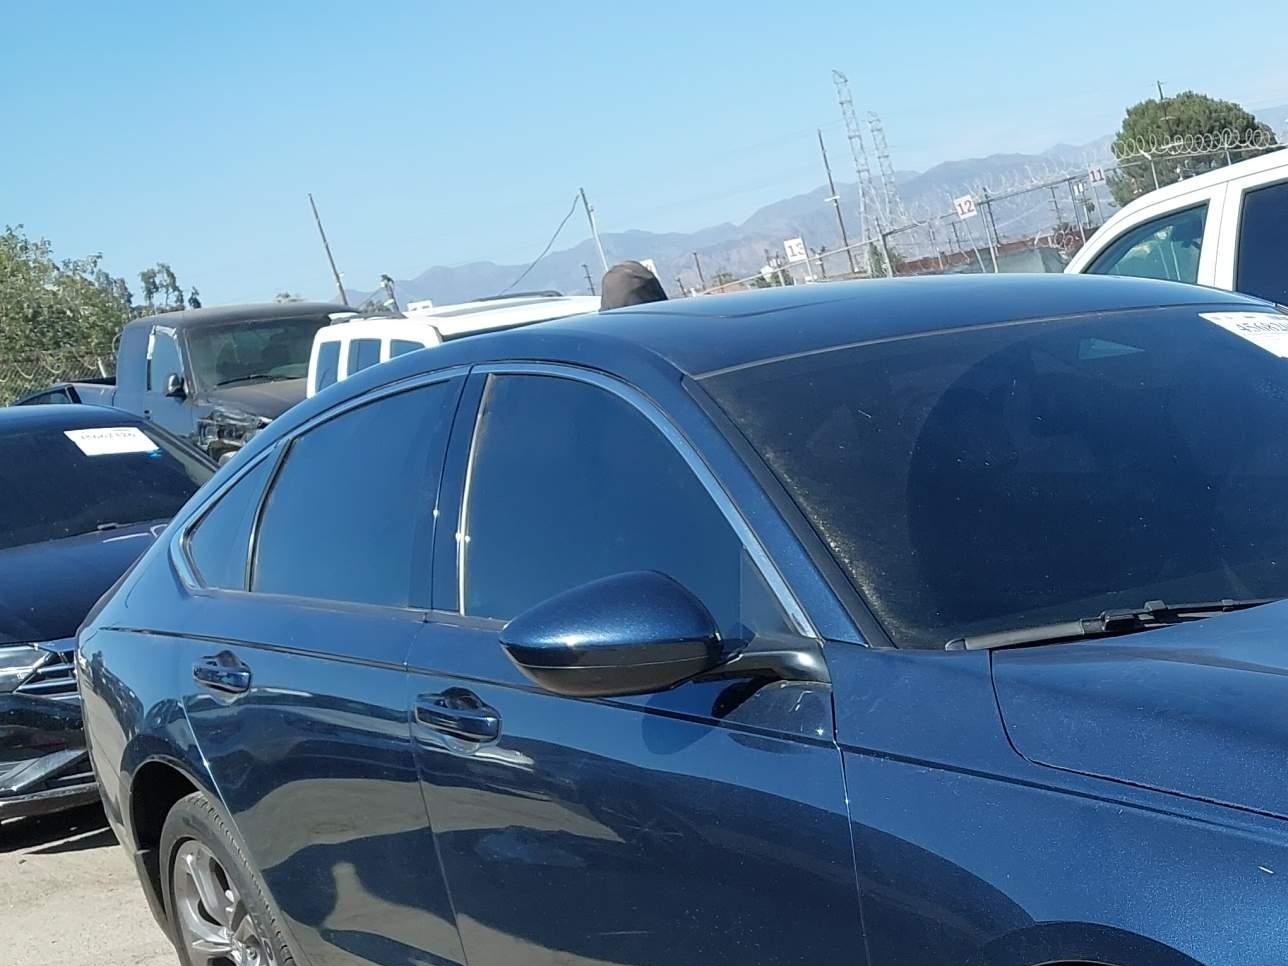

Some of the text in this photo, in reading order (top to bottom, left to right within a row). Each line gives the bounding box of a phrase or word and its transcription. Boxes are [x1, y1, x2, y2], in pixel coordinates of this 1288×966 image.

[1089, 167, 1105, 183] 11
[957, 199, 975, 216] 12
[788, 242, 805, 257] 13
